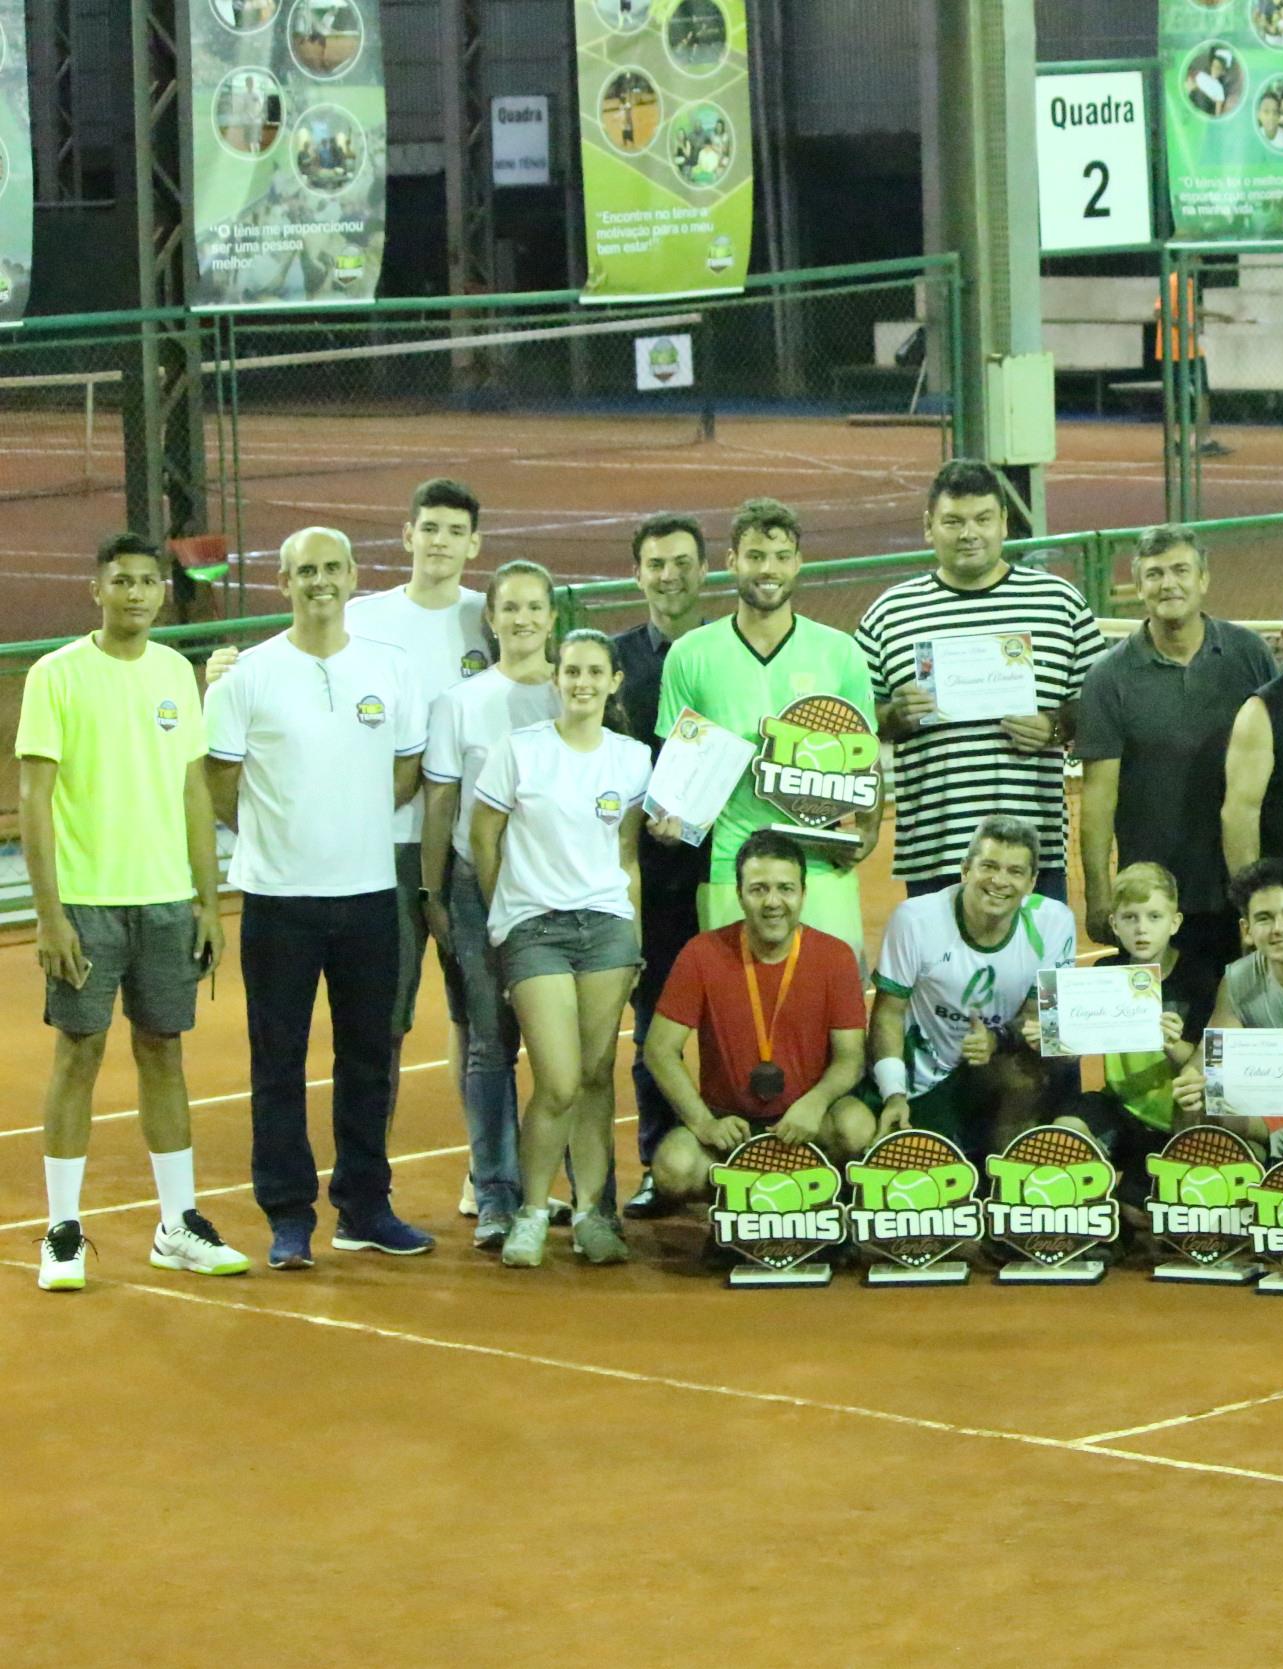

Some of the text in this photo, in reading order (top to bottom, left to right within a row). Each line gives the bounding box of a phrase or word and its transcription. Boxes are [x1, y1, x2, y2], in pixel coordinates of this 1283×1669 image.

[498, 106, 543, 125] Quadra
[1051, 94, 1134, 131] Quadra
[1083, 160, 1111, 218] 2
[261, 239, 303, 254] pessoa
[283, 221, 364, 239] proporcionou
[766, 717, 879, 774] TOP
[760, 761, 877, 807] TENNIS
[714, 1167, 837, 1211] TOP
[850, 1163, 975, 1210] TOP
[988, 1159, 1112, 1204] TOP
[1147, 1159, 1263, 1204] TOP
[714, 1209, 839, 1242] TENNIS
[852, 1205, 978, 1242] TENNIS
[988, 1204, 1112, 1236] TENNIS
